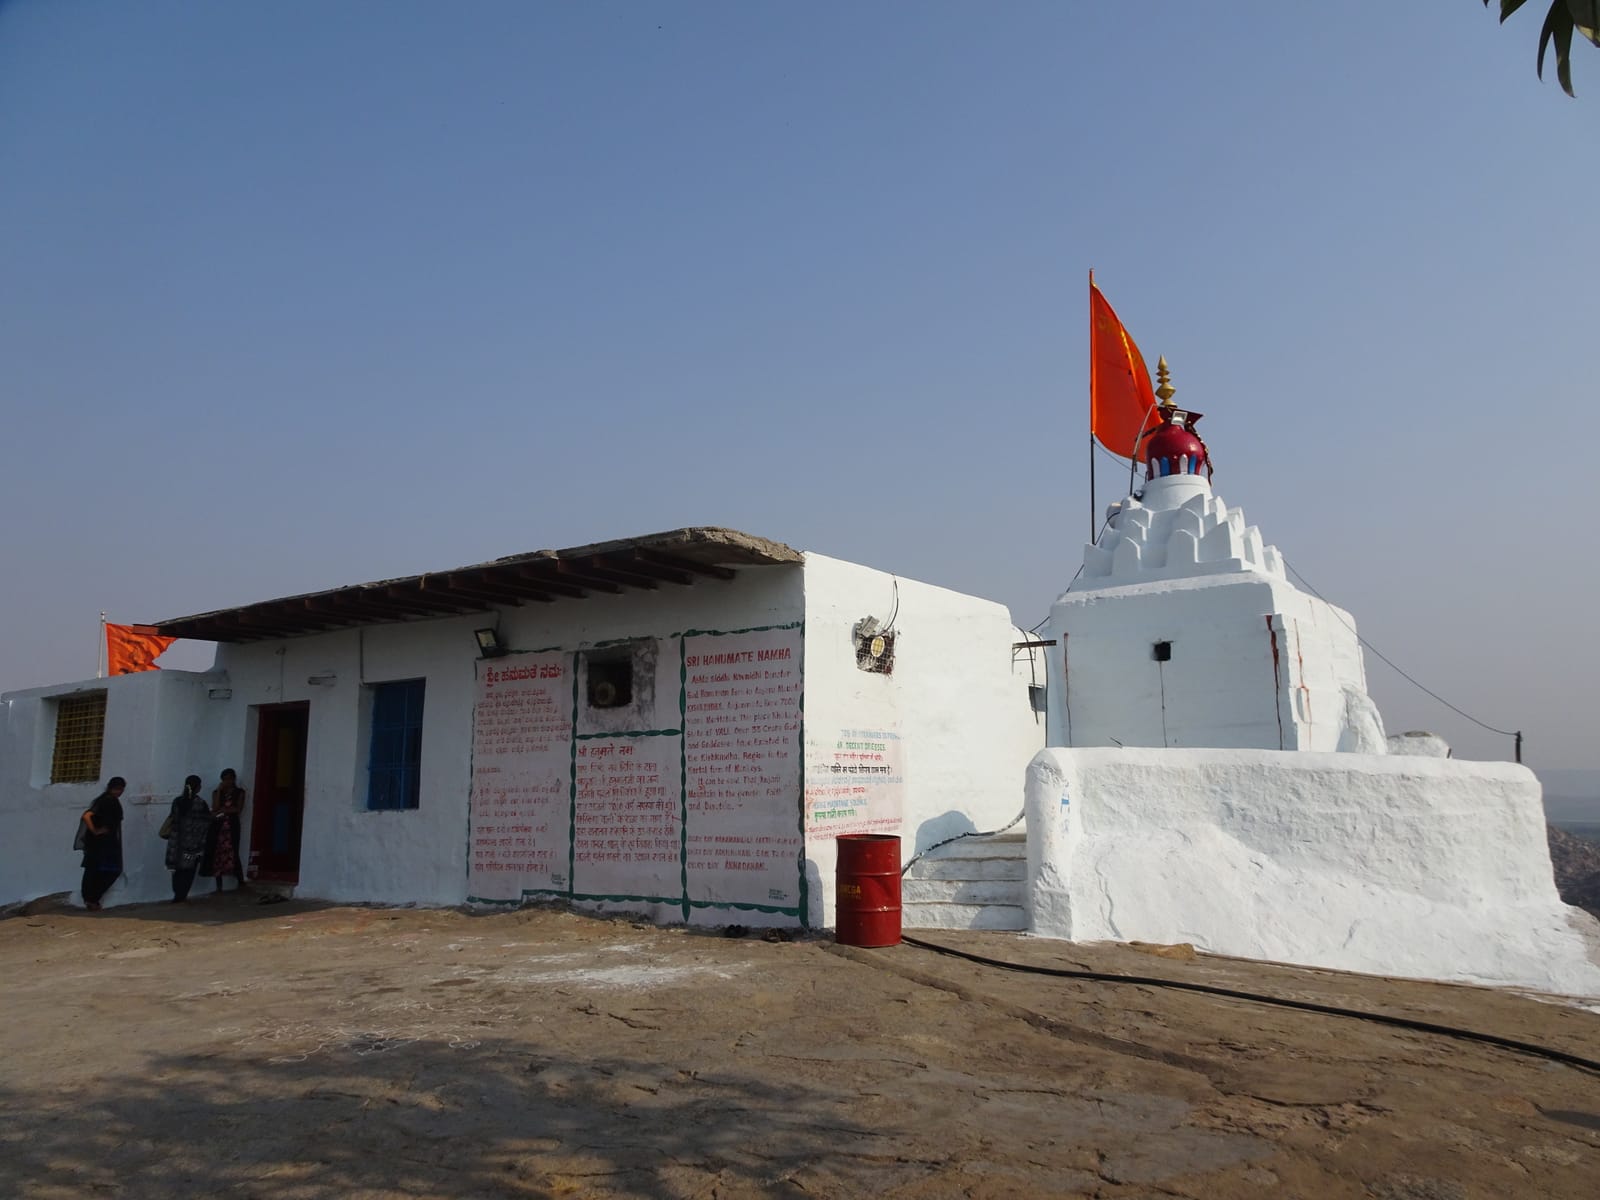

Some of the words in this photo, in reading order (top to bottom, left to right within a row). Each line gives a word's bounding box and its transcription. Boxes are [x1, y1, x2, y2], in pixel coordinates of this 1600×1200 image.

[687, 655, 700, 668] SRI
[703, 651, 754, 666] HANUMATE
[757, 647, 791, 662] NAMHA
